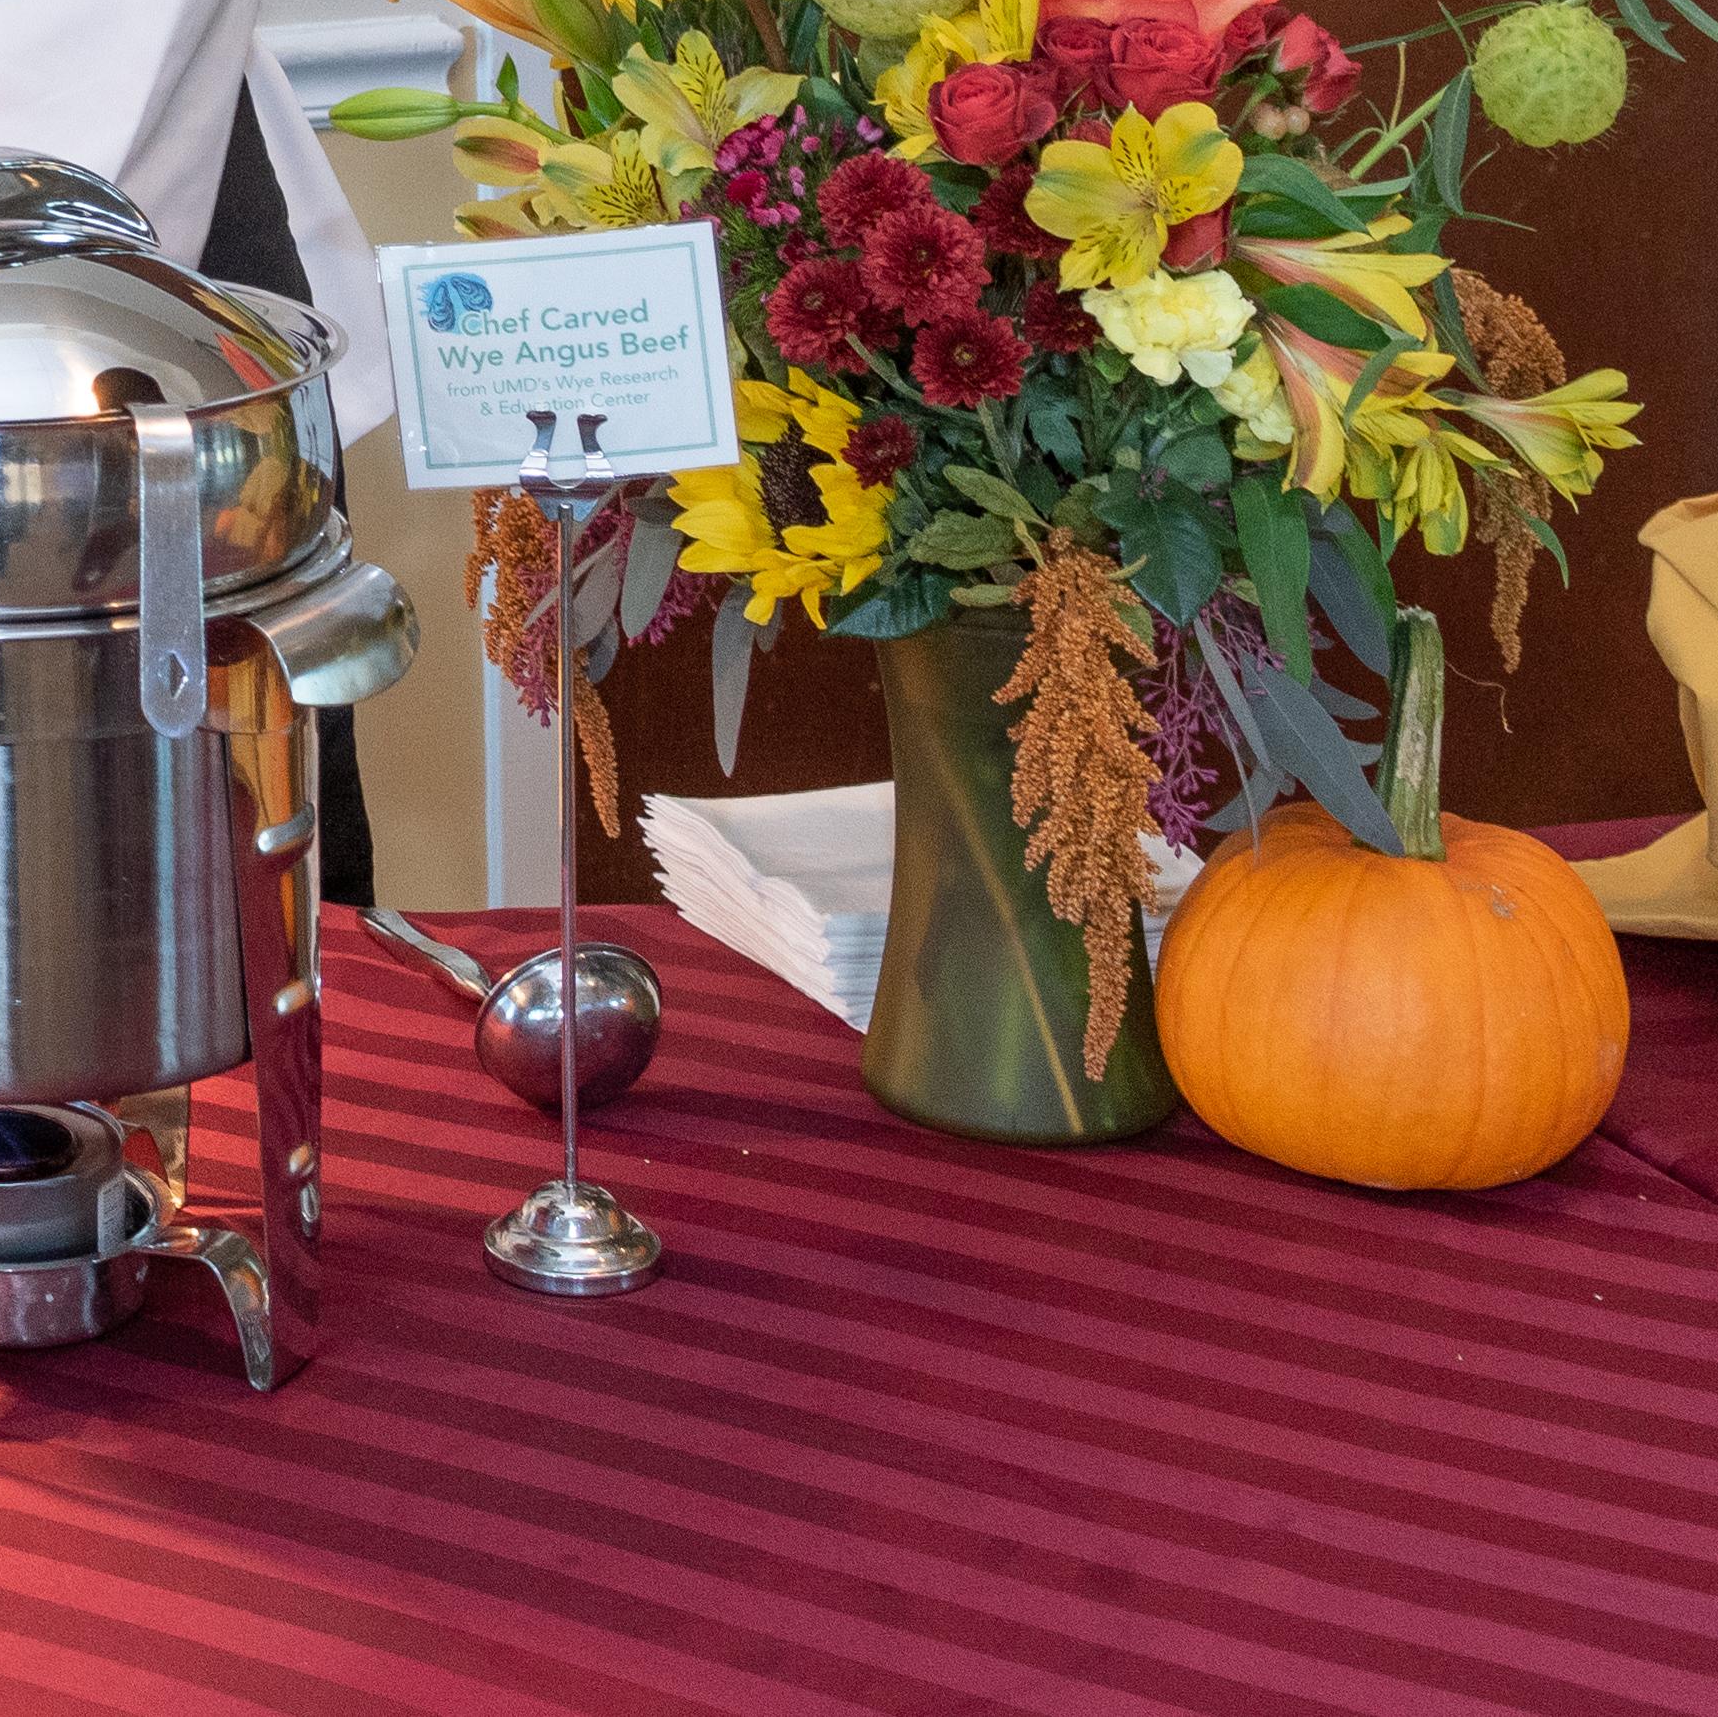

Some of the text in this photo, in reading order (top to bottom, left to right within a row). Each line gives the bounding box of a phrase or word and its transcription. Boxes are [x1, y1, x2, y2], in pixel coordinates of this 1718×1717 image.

[461, 298, 649, 337] Chef Carved
[438, 325, 689, 375] Wye Angus Beef
[447, 365, 679, 398] from UMD's Wye Research
[480, 401, 493, 416] &
[591, 391, 651, 408] Center
